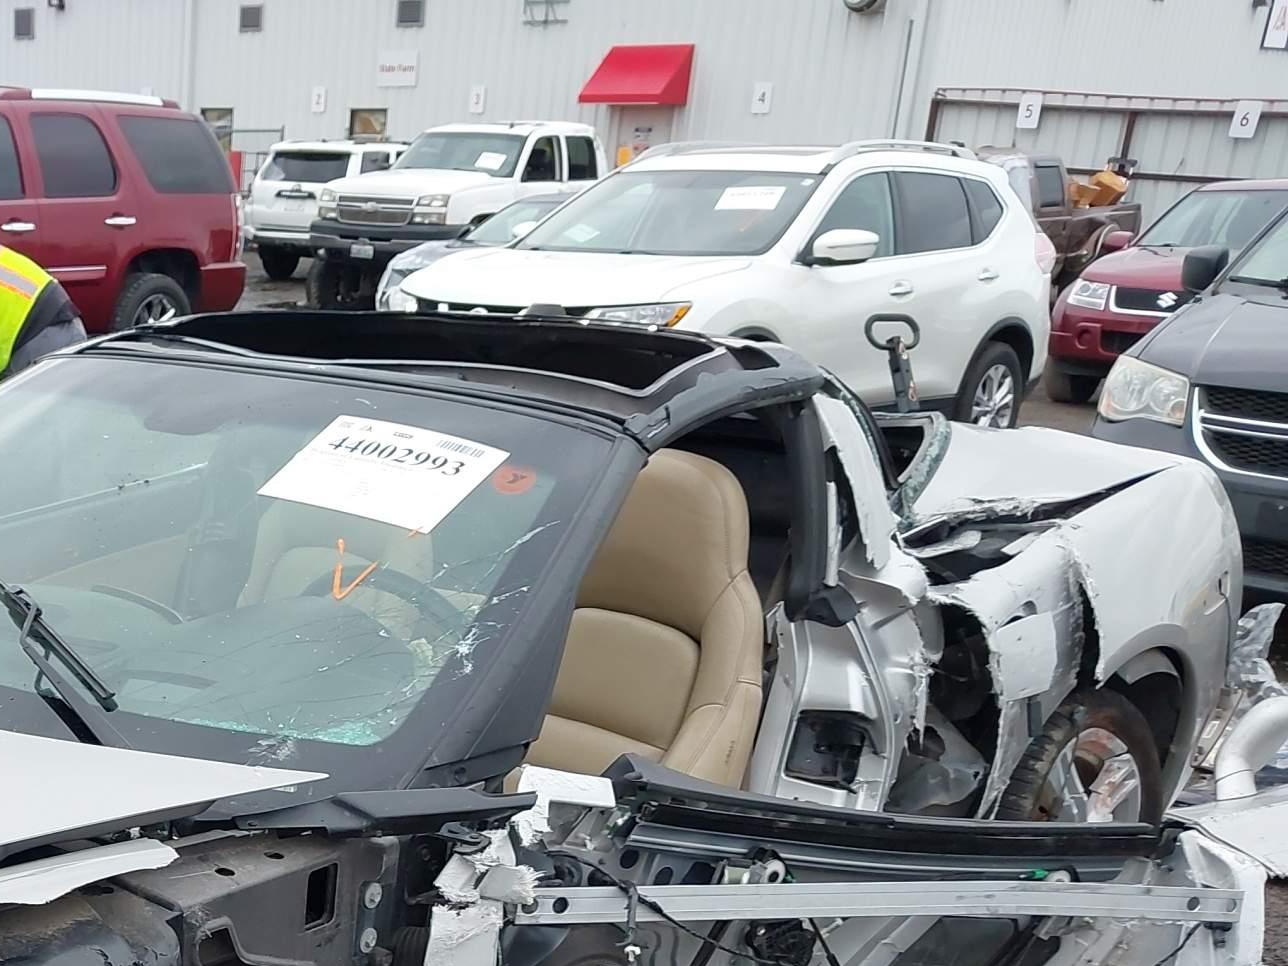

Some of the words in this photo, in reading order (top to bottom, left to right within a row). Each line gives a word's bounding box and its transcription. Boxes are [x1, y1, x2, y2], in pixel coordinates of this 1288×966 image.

[757, 90, 767, 104] 4
[1024, 104, 1034, 119] 5
[1239, 111, 1250, 127] 6
[328, 435, 466, 476] 44002993
